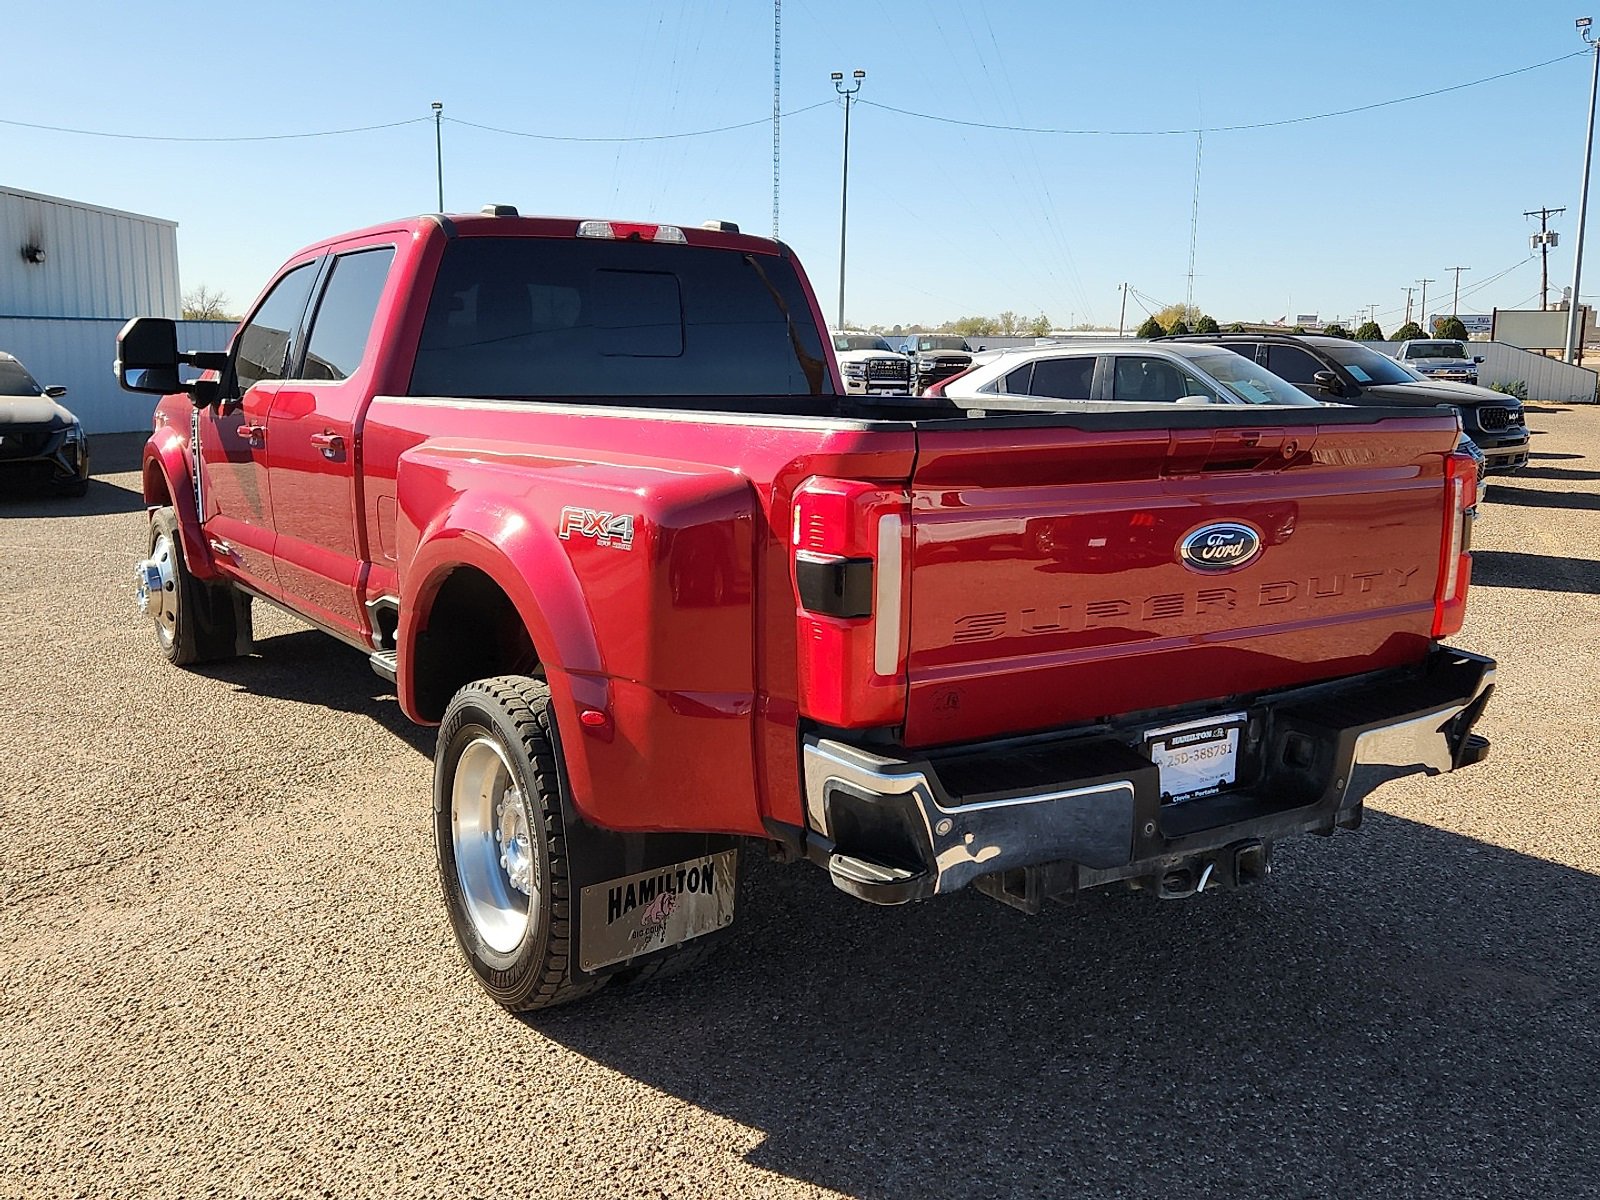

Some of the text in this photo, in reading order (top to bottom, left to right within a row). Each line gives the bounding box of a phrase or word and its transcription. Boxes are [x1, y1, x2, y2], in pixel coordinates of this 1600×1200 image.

[559, 505, 634, 544] FX4
[1202, 533, 1244, 559] Ford
[953, 566, 1420, 645] SUPER DUTY
[1172, 731, 1212, 745] HAMILTON
[607, 862, 715, 925] HAMILTON
[632, 929, 644, 939] BIG
